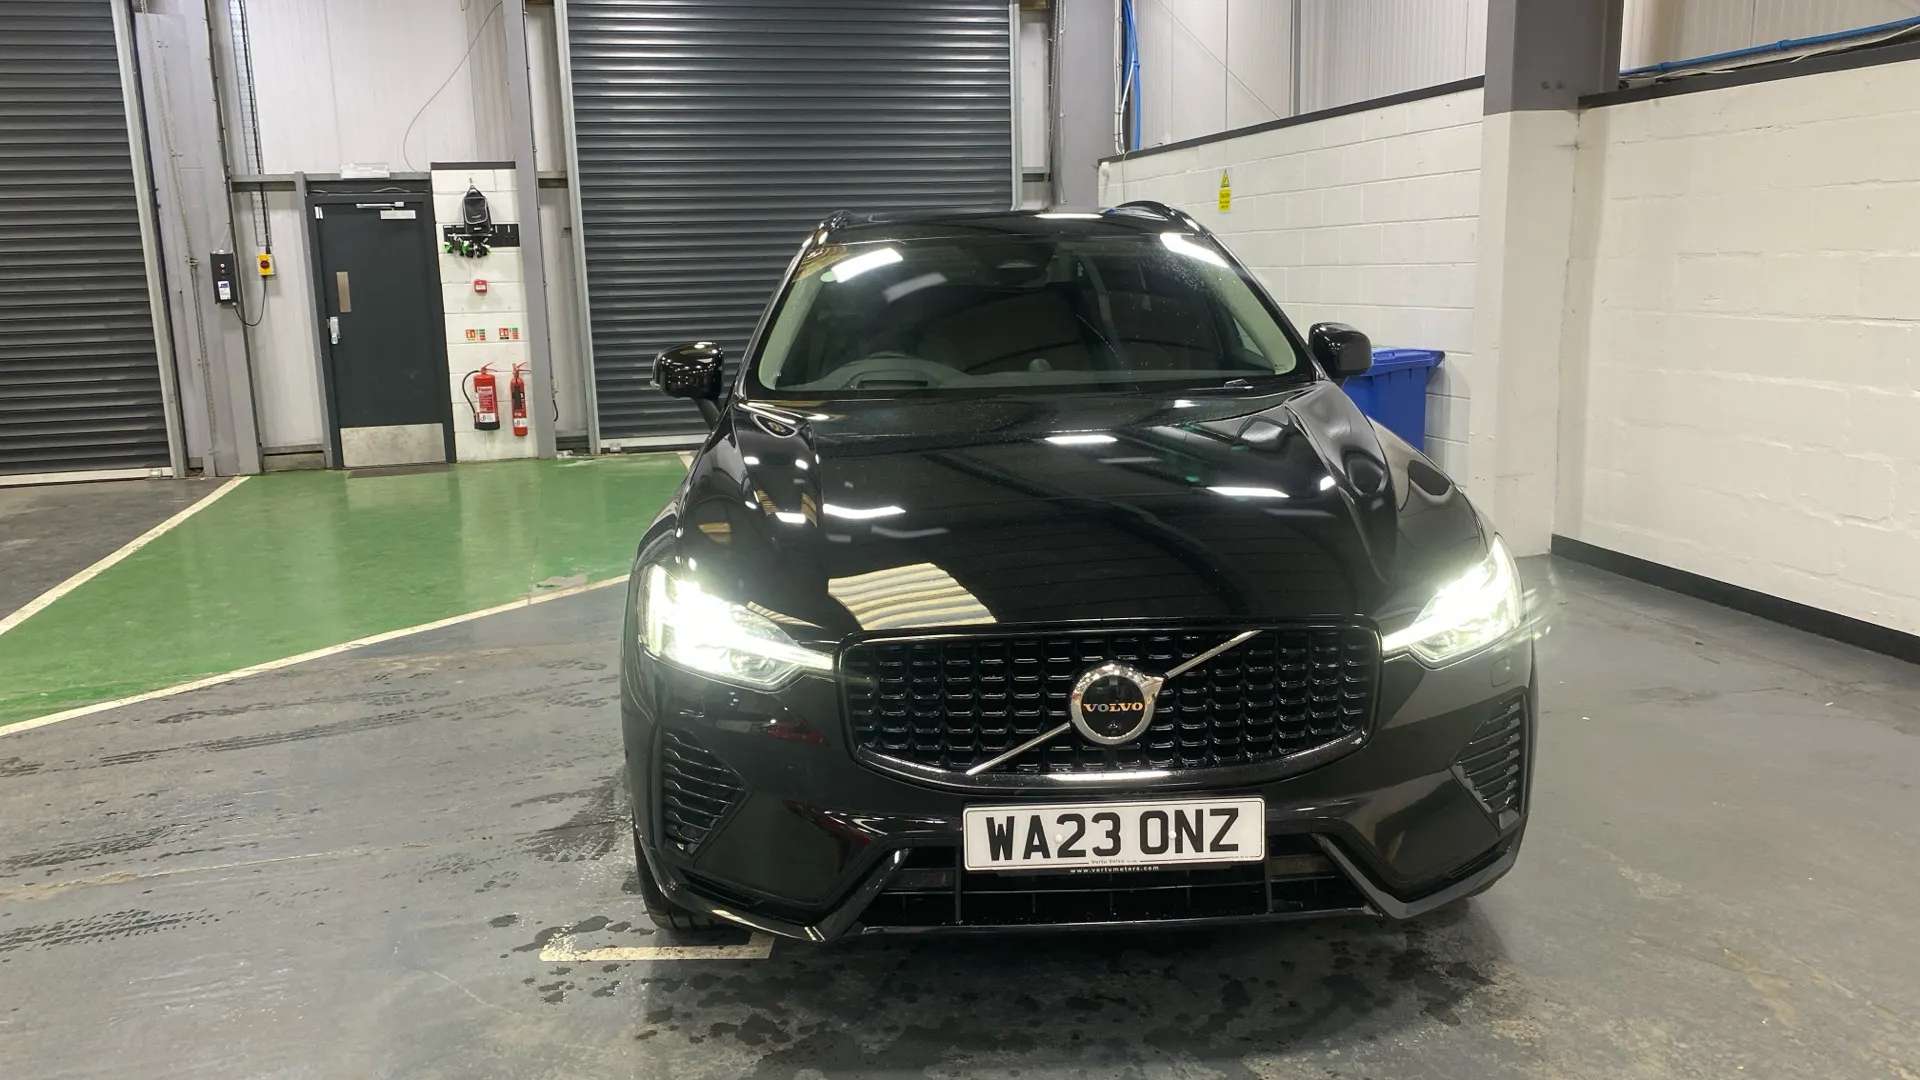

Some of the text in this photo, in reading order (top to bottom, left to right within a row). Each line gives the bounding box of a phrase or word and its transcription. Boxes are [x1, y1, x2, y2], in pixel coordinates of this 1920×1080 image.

[1083, 702, 1144, 712] VOLVO
[985, 807, 1239, 861] WA23 ONZ
